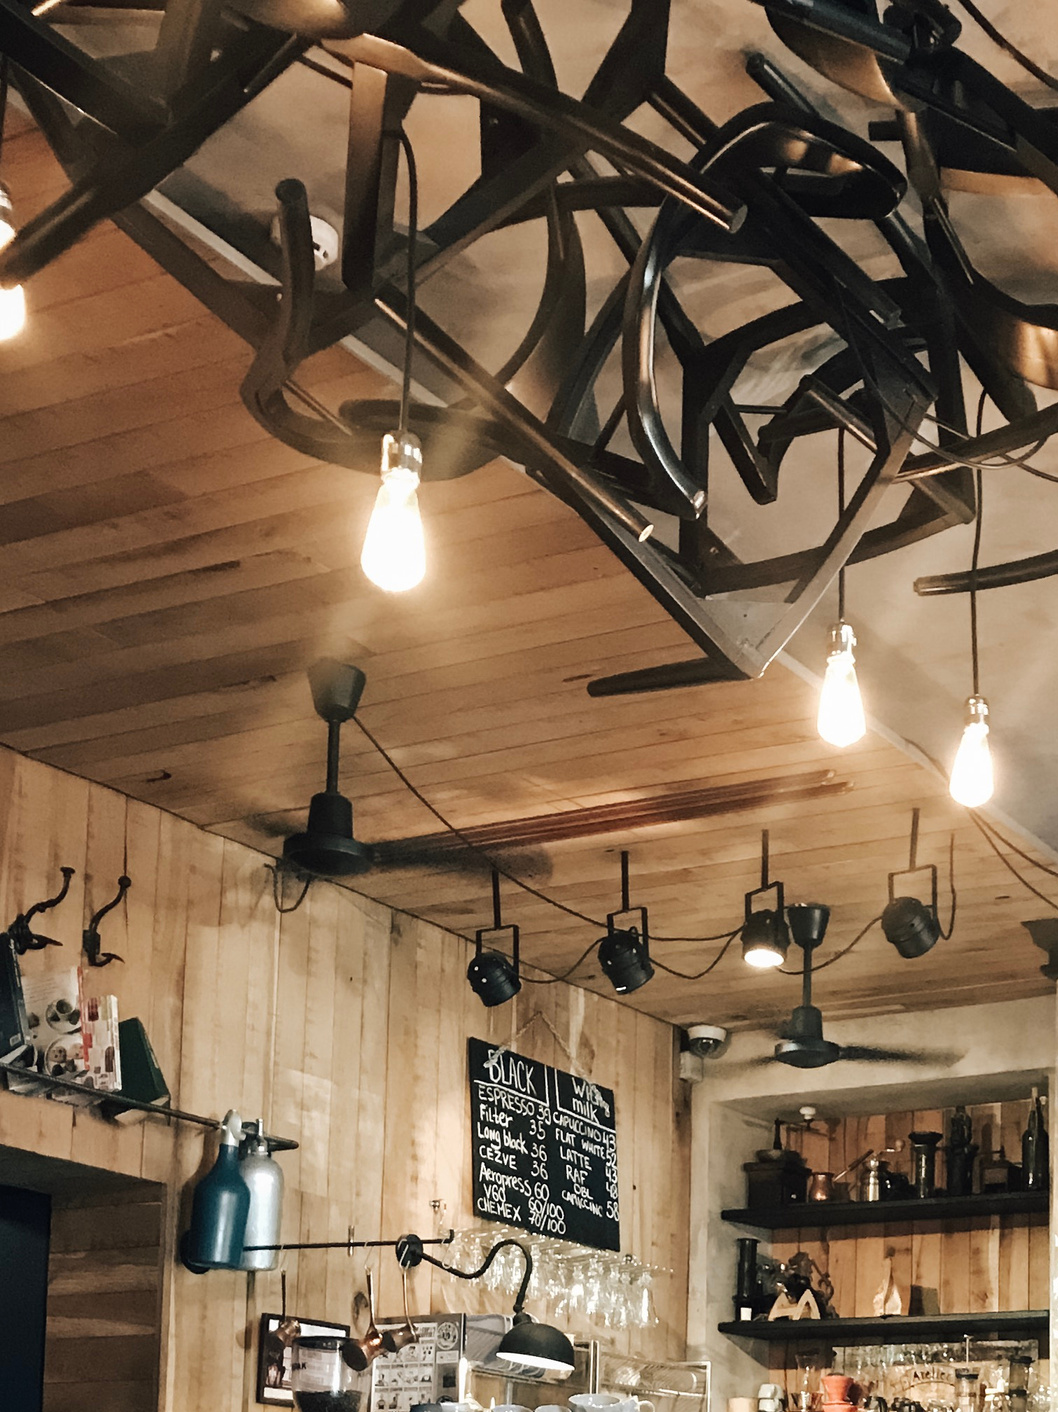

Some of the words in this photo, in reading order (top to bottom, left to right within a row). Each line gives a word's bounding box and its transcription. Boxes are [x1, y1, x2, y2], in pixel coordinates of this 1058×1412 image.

[479, 1085, 535, 1116] ESPRESSO
[536, 1105, 551, 1125] 39
[477, 1121, 501, 1151] Long
[503, 1129, 529, 1154] black
[530, 1142, 547, 1162] 36
[529, 1119, 546, 1140] 35
[603, 1131, 616, 1153] 43
[479, 1145, 518, 1170] CEZVE
[530, 1160, 549, 1180] 36
[556, 1127, 576, 1147] FLAT
[605, 1149, 618, 1169] 52
[560, 1146, 593, 1171] LATTE
[605, 1166, 618, 1183] 43
[479, 1161, 532, 1197] Aeropress
[534, 1182, 549, 1201] 60
[566, 1164, 589, 1185] RAF
[477, 1197, 522, 1221] CHEMEX
[483, 1183, 506, 1202] V60
[528, 1197, 564, 1221] 60/100
[606, 1201, 620, 1222] 58
